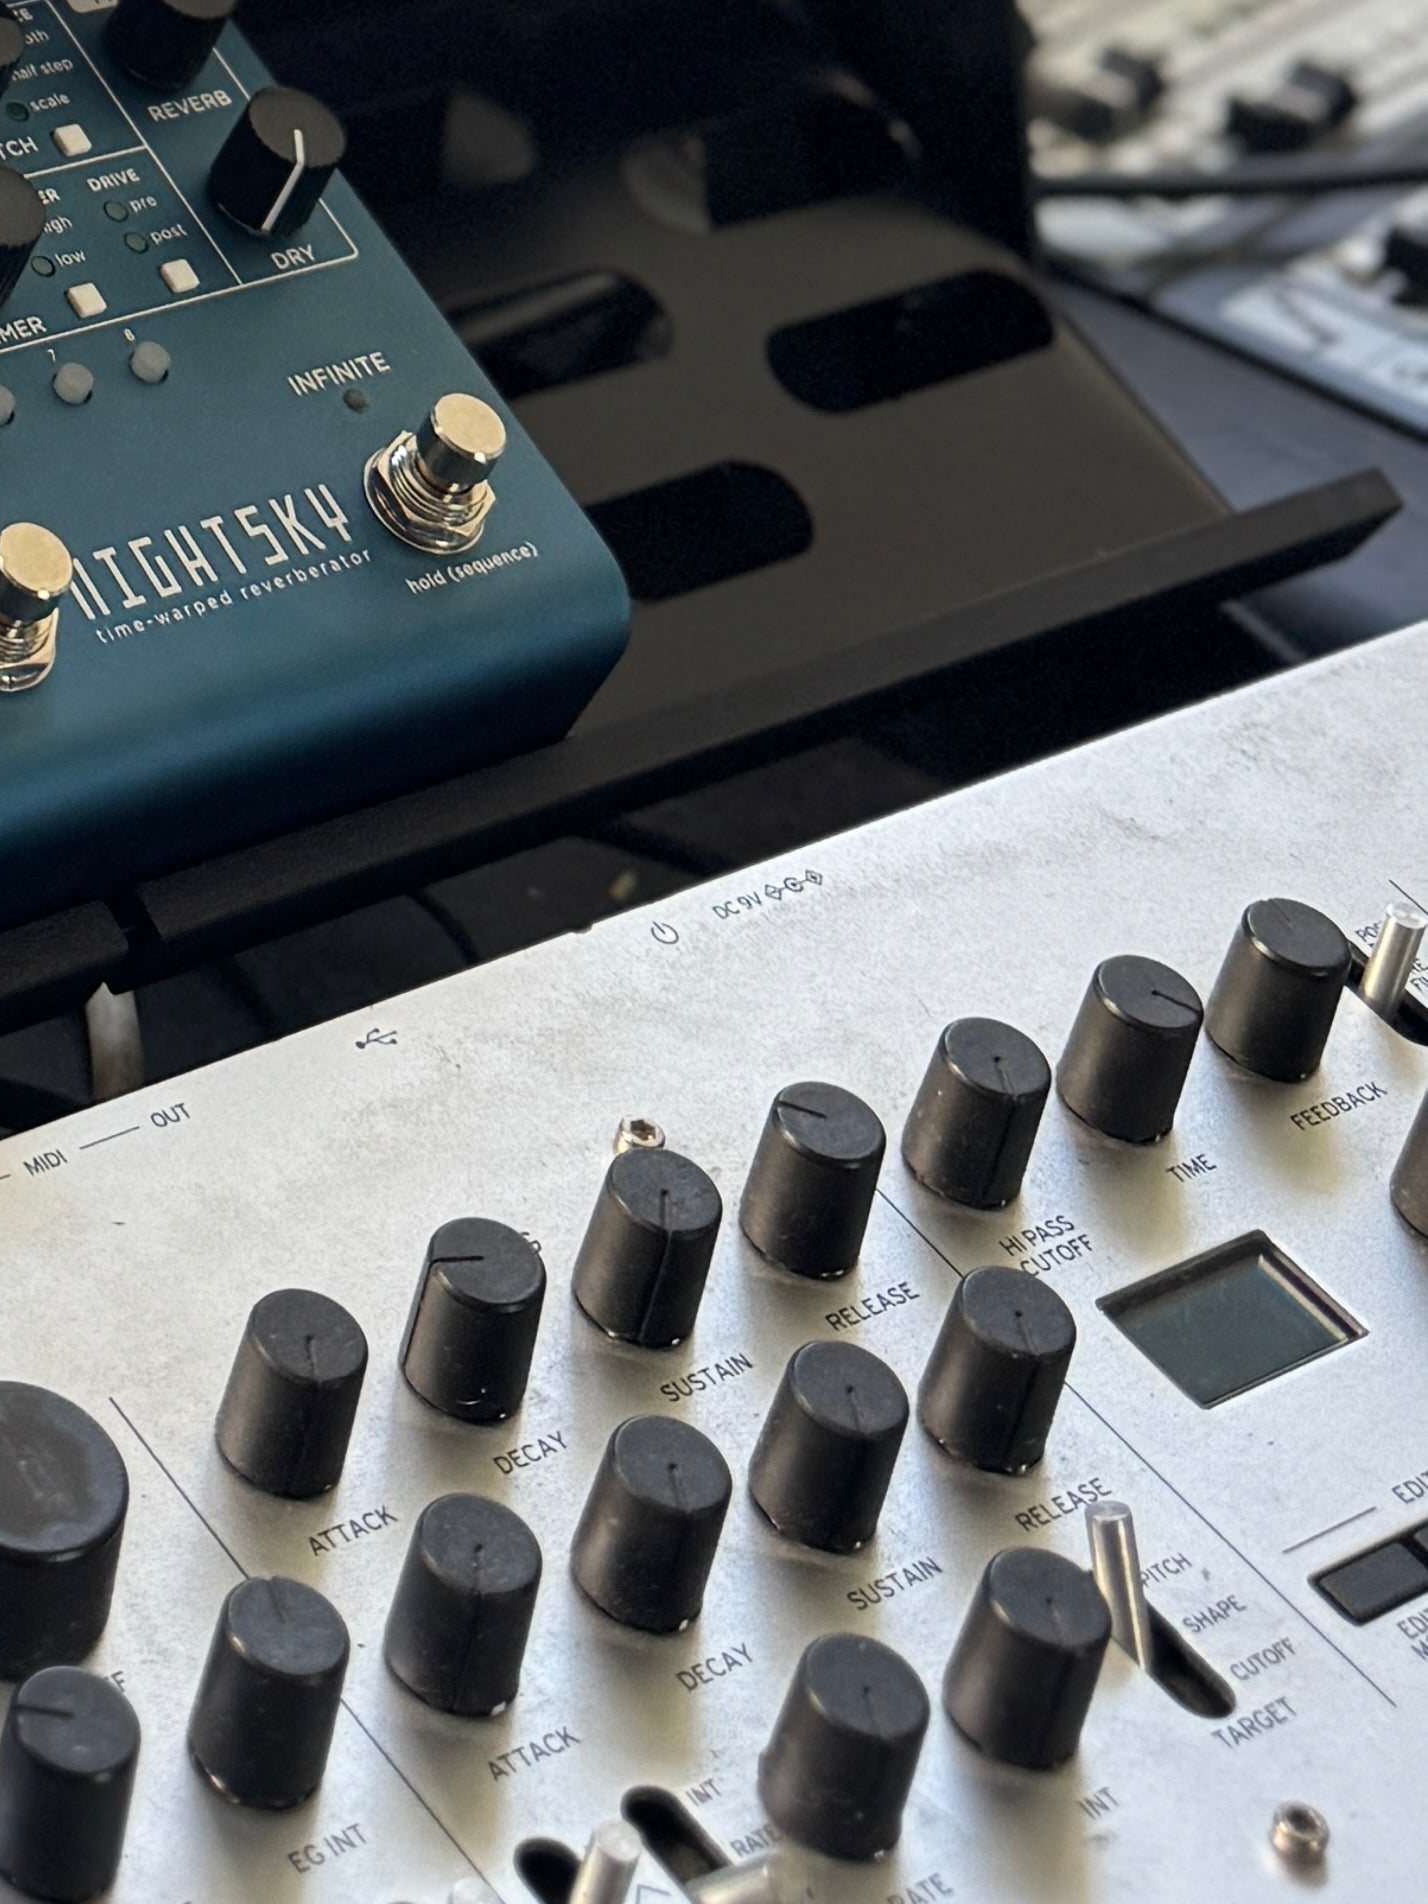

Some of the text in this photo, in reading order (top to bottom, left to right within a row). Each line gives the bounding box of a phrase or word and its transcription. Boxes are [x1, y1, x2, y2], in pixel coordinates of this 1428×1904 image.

[40, 58, 73, 76] step
[30, 92, 70, 112] scale
[148, 90, 232, 122] REVERB
[86, 168, 140, 192] DRIVE
[130, 194, 157, 215] pre
[150, 223, 188, 247] post
[56, 248, 86, 268] low
[270, 245, 317, 271] DRY
[288, 352, 390, 396] INFINITE
[71, 483, 352, 621] NIGHTSKY
[405, 540, 539, 595] hold (sequence)
[96, 546, 373, 645] time-warped reverberator
[712, 893, 763, 920] DC 9V
[1290, 1081, 1387, 1133] FEEDBACK
[23, 1148, 68, 1178] MIDI
[150, 1102, 192, 1130] OUT
[1166, 1153, 1217, 1184] TIME
[1000, 1214, 1076, 1256] HI PASS
[1020, 1234, 1094, 1278] CUTOFF
[824, 1281, 921, 1332] RELEASE
[660, 1352, 753, 1404] SUSTAIN
[493, 1430, 569, 1476] DECAY
[1014, 1477, 1114, 1533] RELEASE
[308, 1504, 399, 1557] ATTACK
[846, 1556, 944, 1611] SUSTAIN
[1181, 1593, 1247, 1634] SHAPE
[675, 1643, 754, 1693] DECAY
[1229, 1637, 1297, 1682] CUTOFF
[1211, 1697, 1298, 1752] TARGET
[488, 1725, 581, 1781] ATTACK
[685, 1778, 720, 1808] INT
[1078, 1787, 1121, 1821] INT
[288, 1823, 368, 1874] EG INT
[730, 1823, 784, 1857] RATE
